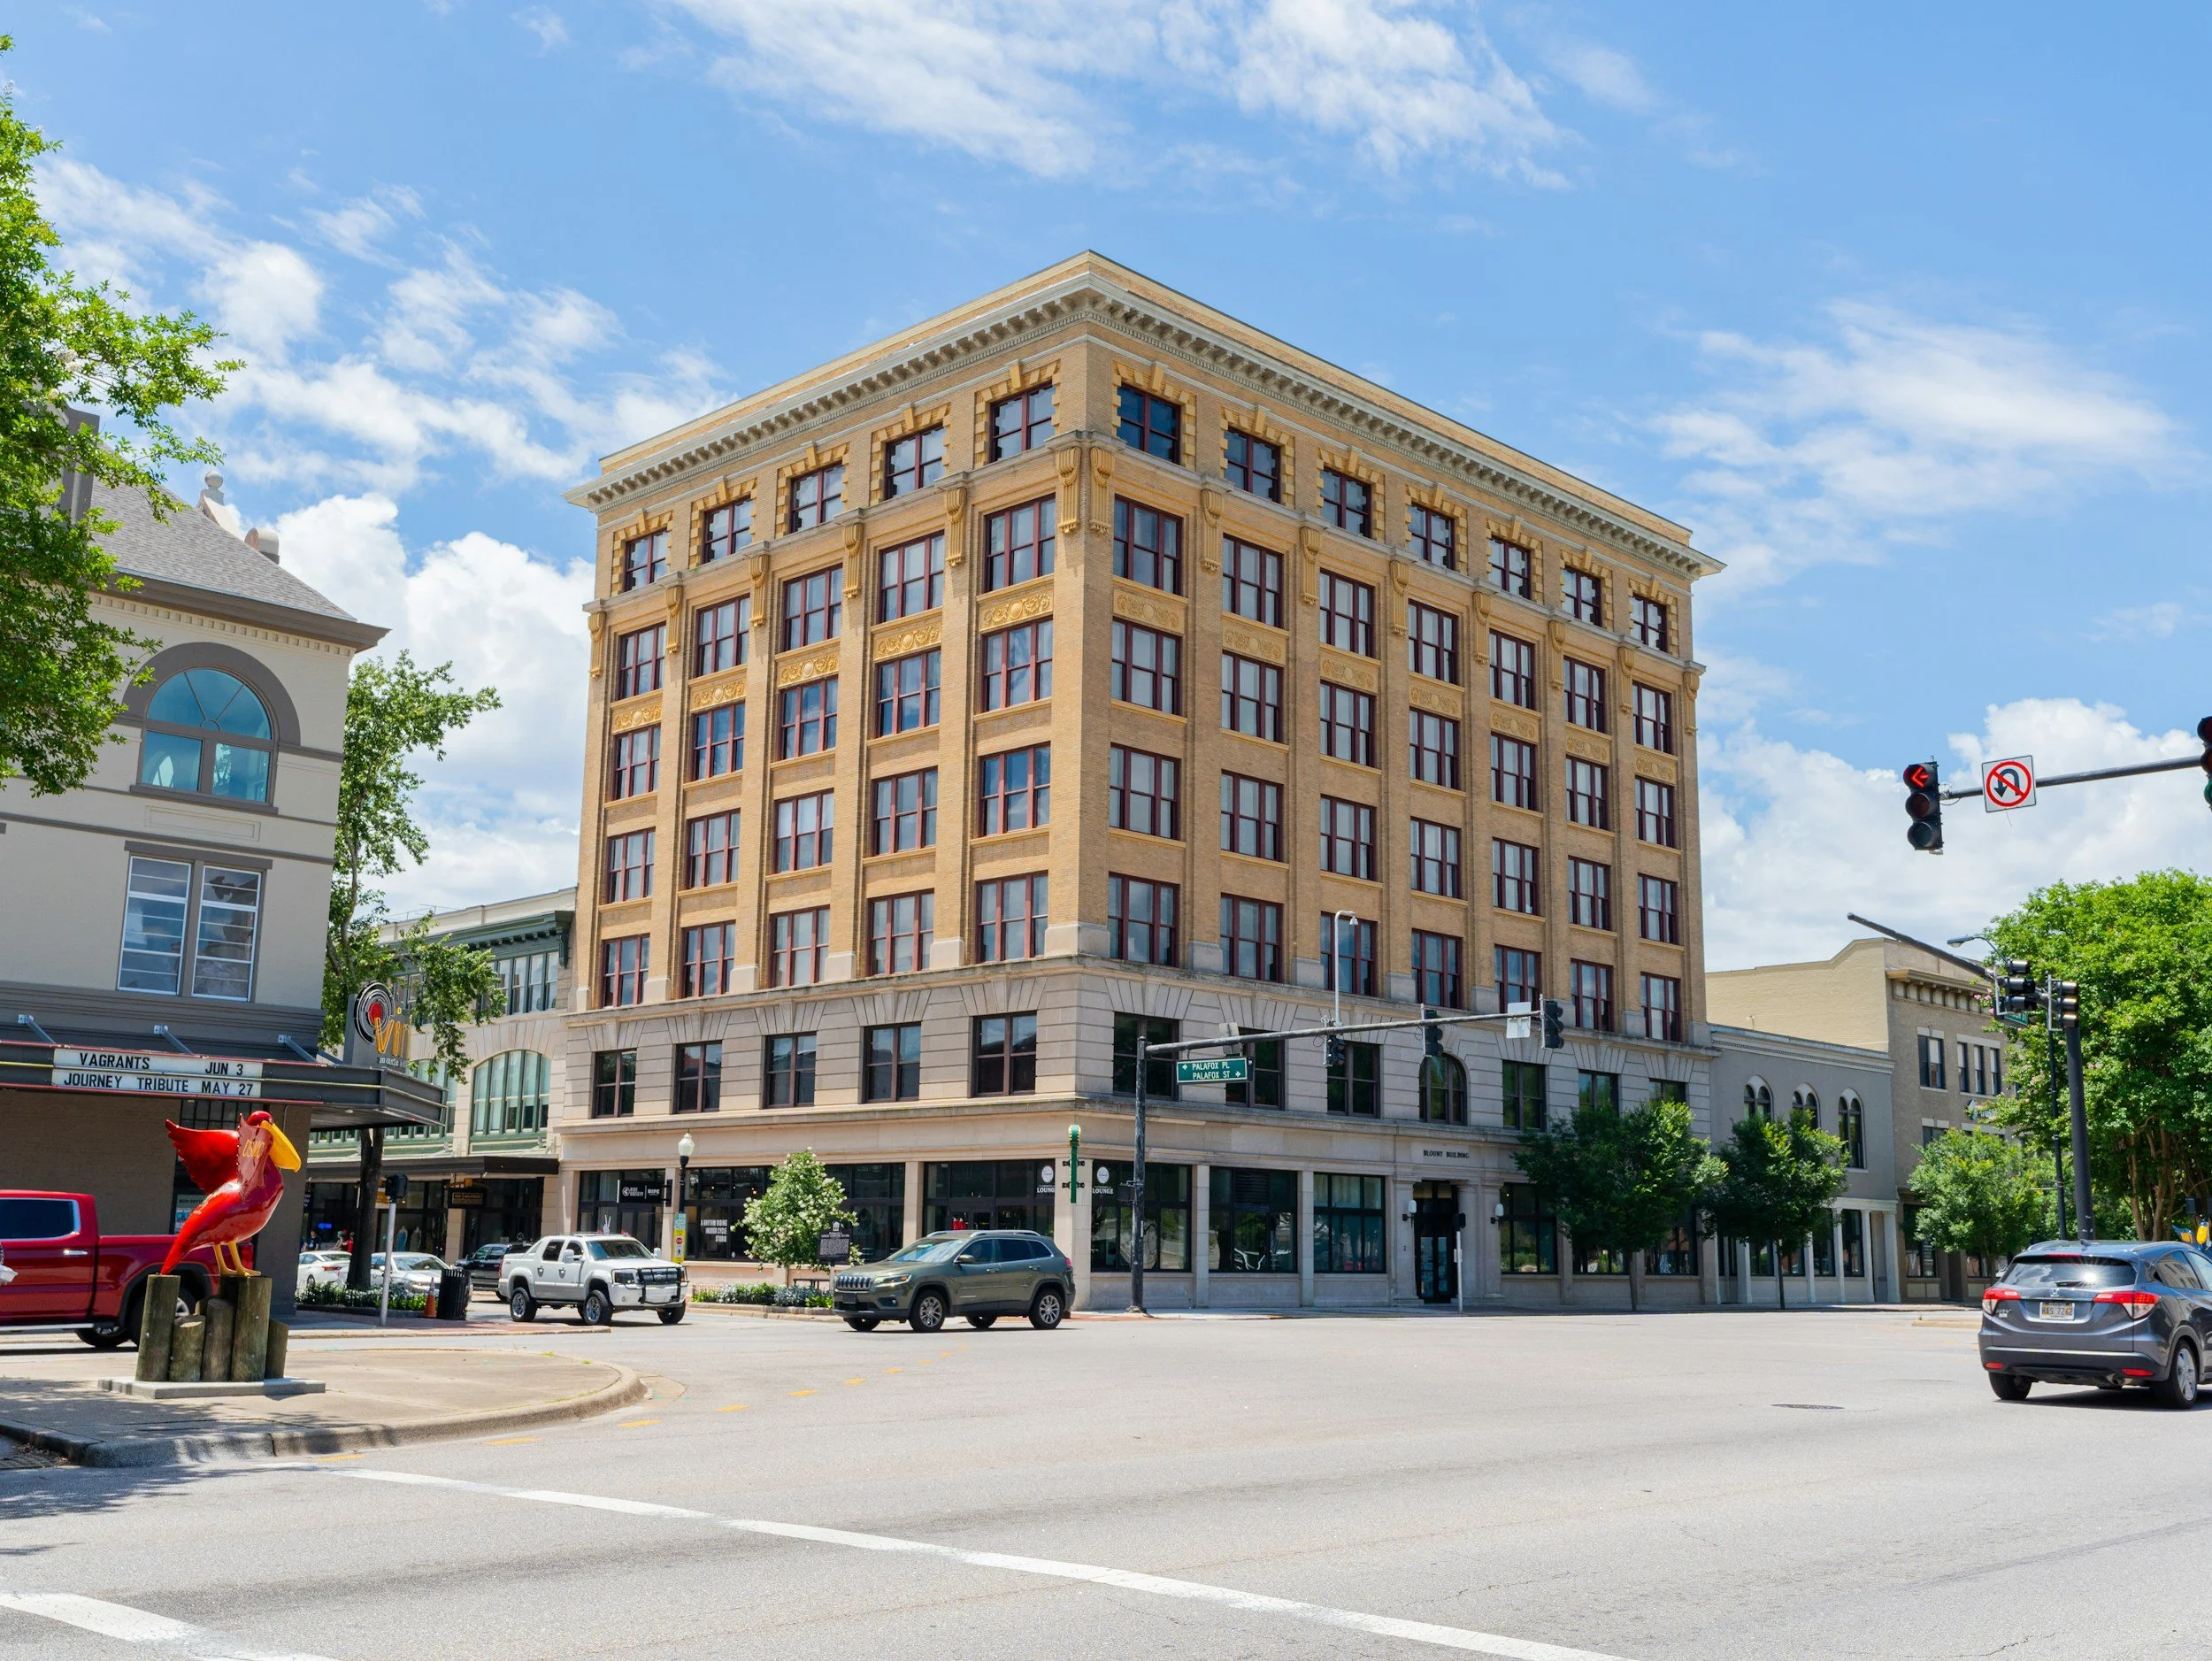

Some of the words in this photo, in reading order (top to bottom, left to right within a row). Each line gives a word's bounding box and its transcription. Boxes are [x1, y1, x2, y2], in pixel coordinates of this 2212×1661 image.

[80, 1052, 150, 1070] VAGRANTS
[205, 1062, 228, 1076] JUN
[236, 1064, 243, 1076] 3
[1192, 1062, 1219, 1071] PALAFOX
[1192, 1071, 1220, 1080] PALAFOX
[1223, 1070, 1231, 1079] ST
[64, 1073, 123, 1088] JOURNEY
[137, 1077, 188, 1092] TRIBUTE
[202, 1080, 230, 1095] MAY
[239, 1083, 253, 1096] 27
